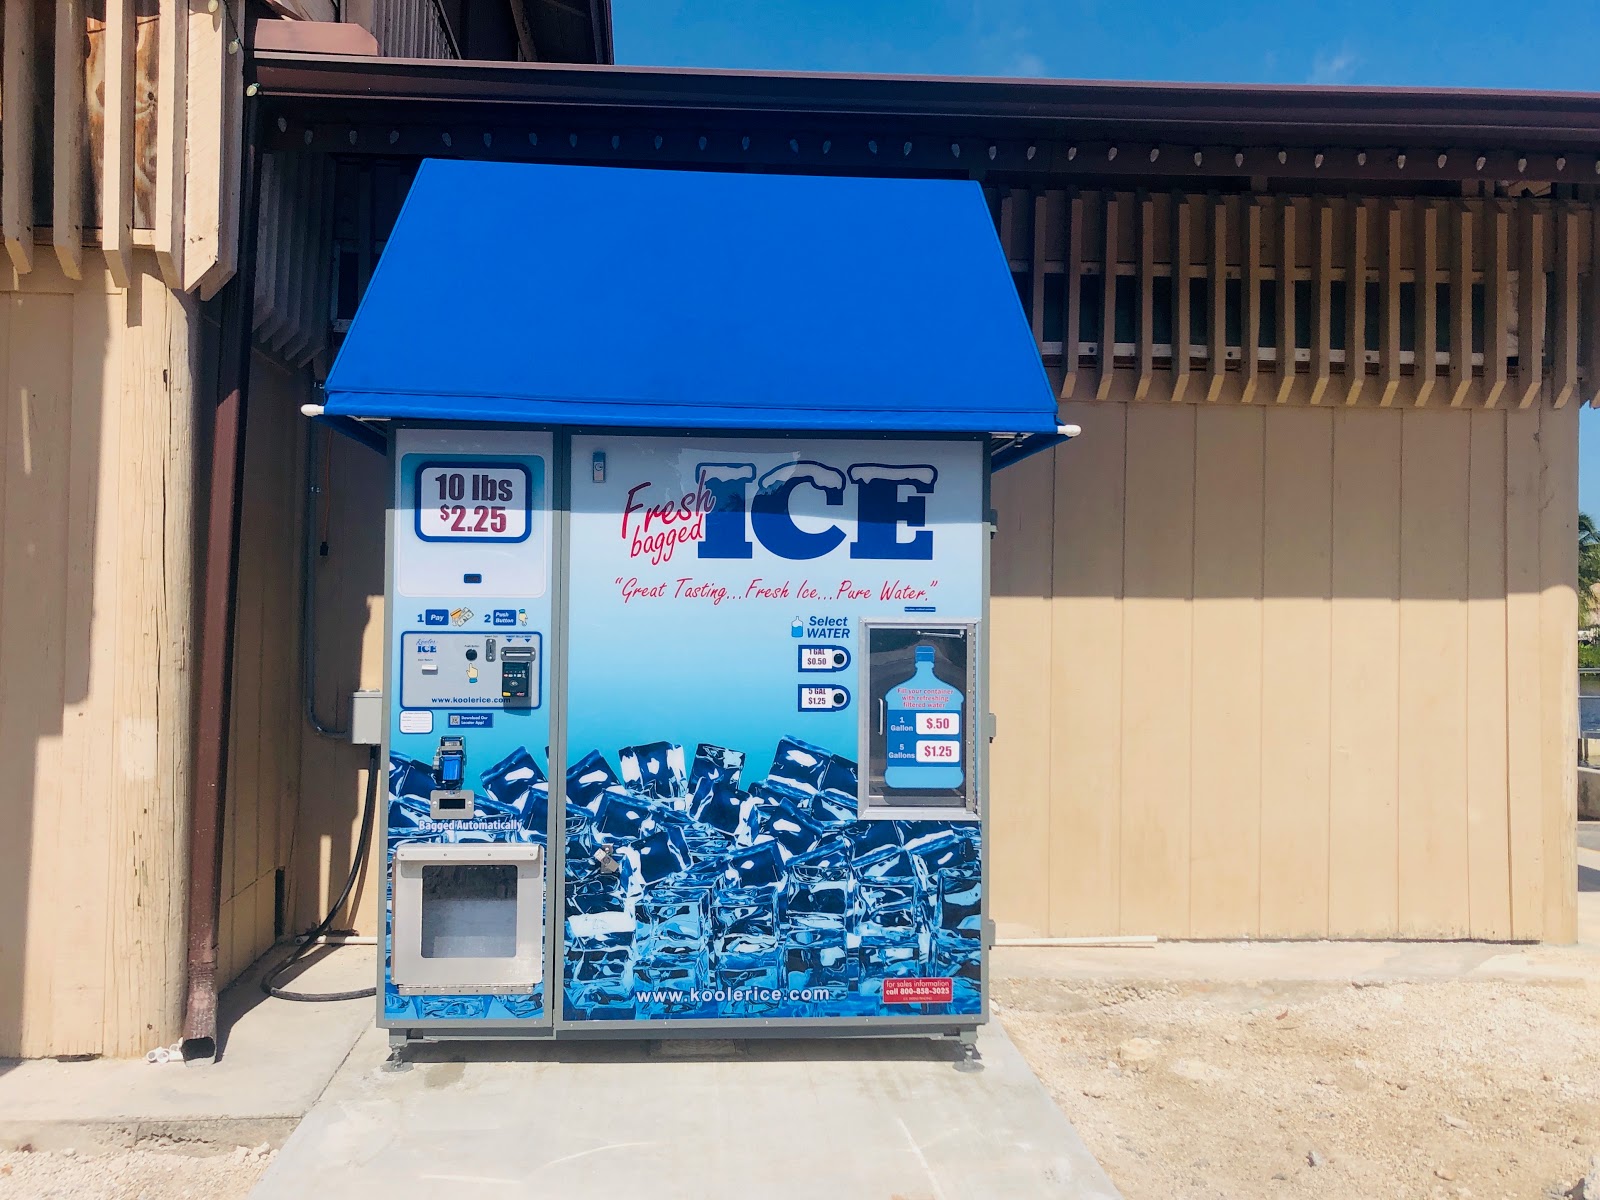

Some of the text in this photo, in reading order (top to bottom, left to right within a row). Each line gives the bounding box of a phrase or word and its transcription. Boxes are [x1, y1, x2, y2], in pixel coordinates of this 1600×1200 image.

[435, 474, 513, 502] 10 lbs
[620, 469, 716, 539] Fresh
[694, 460, 938, 560] ICE
[440, 504, 507, 533] $2.25
[630, 516, 703, 566] bagged
[417, 614, 444, 622] 1 Pay
[484, 614, 491, 623] 2
[808, 616, 848, 627] Select
[806, 628, 850, 639] WATER
[808, 657, 827, 665] $0.50
[808, 696, 826, 705] $1.25
[926, 718, 950, 730] $.50
[924, 745, 952, 757] $1.25
[418, 820, 522, 833] Bagged Automatically
[636, 986, 830, 1003] www.koolerice.com
